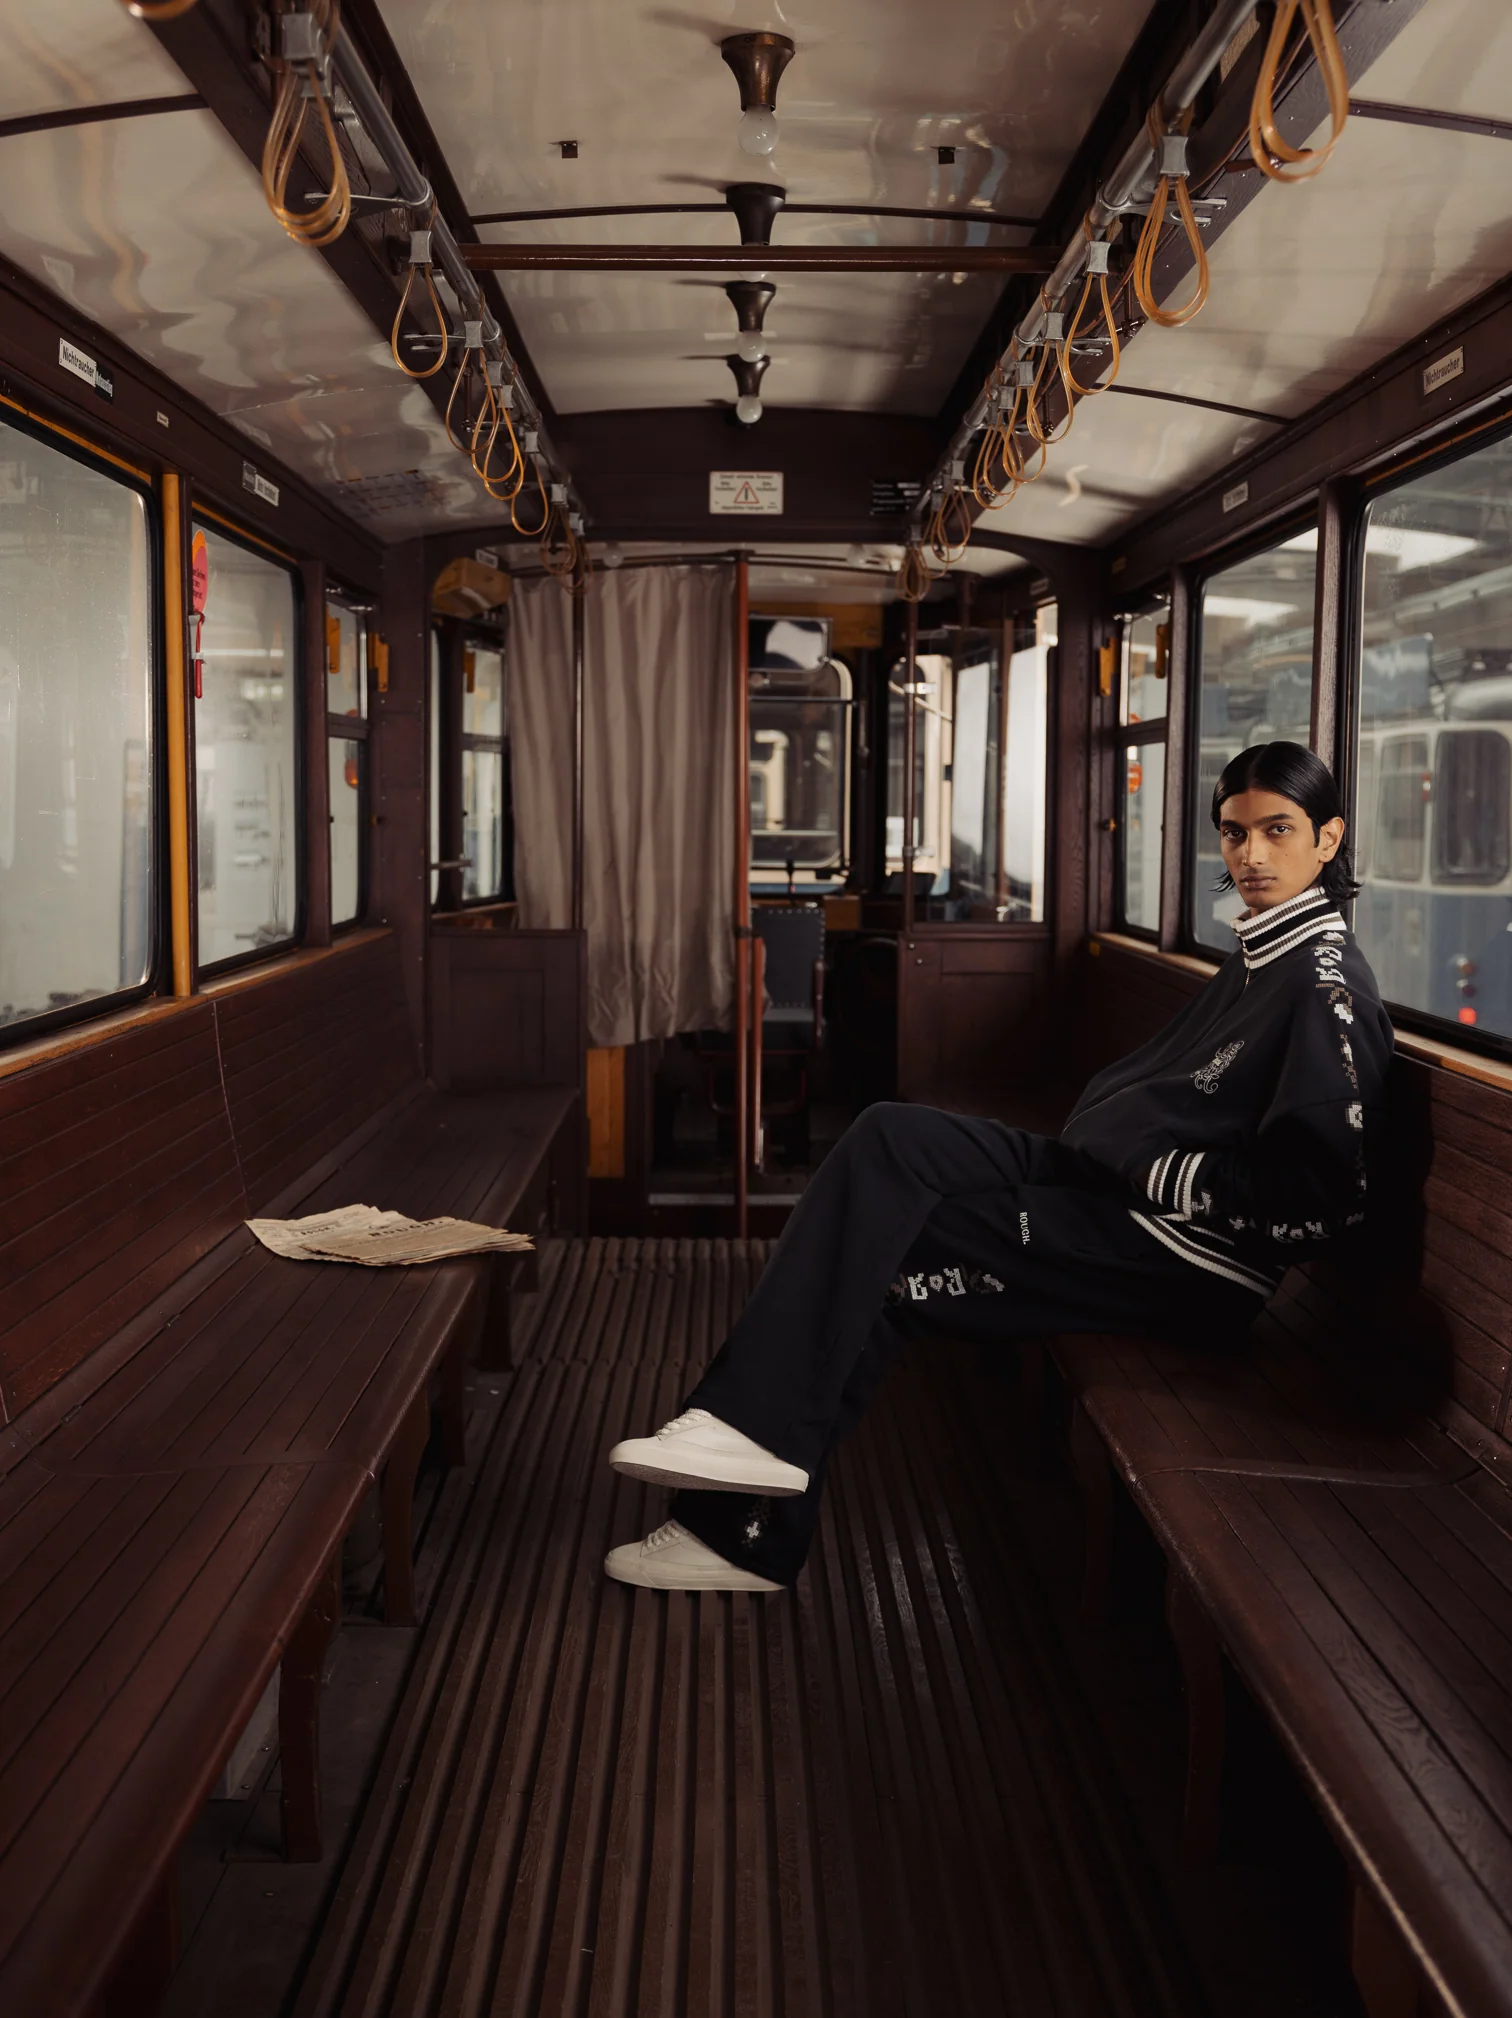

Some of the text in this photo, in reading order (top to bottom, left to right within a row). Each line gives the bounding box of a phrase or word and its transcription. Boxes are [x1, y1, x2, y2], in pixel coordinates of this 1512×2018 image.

[62, 345, 94, 379] Nichtraucher
[1425, 357, 1460, 388] Nichtraucher
[1019, 1211, 1031, 1246] ROUGH.
